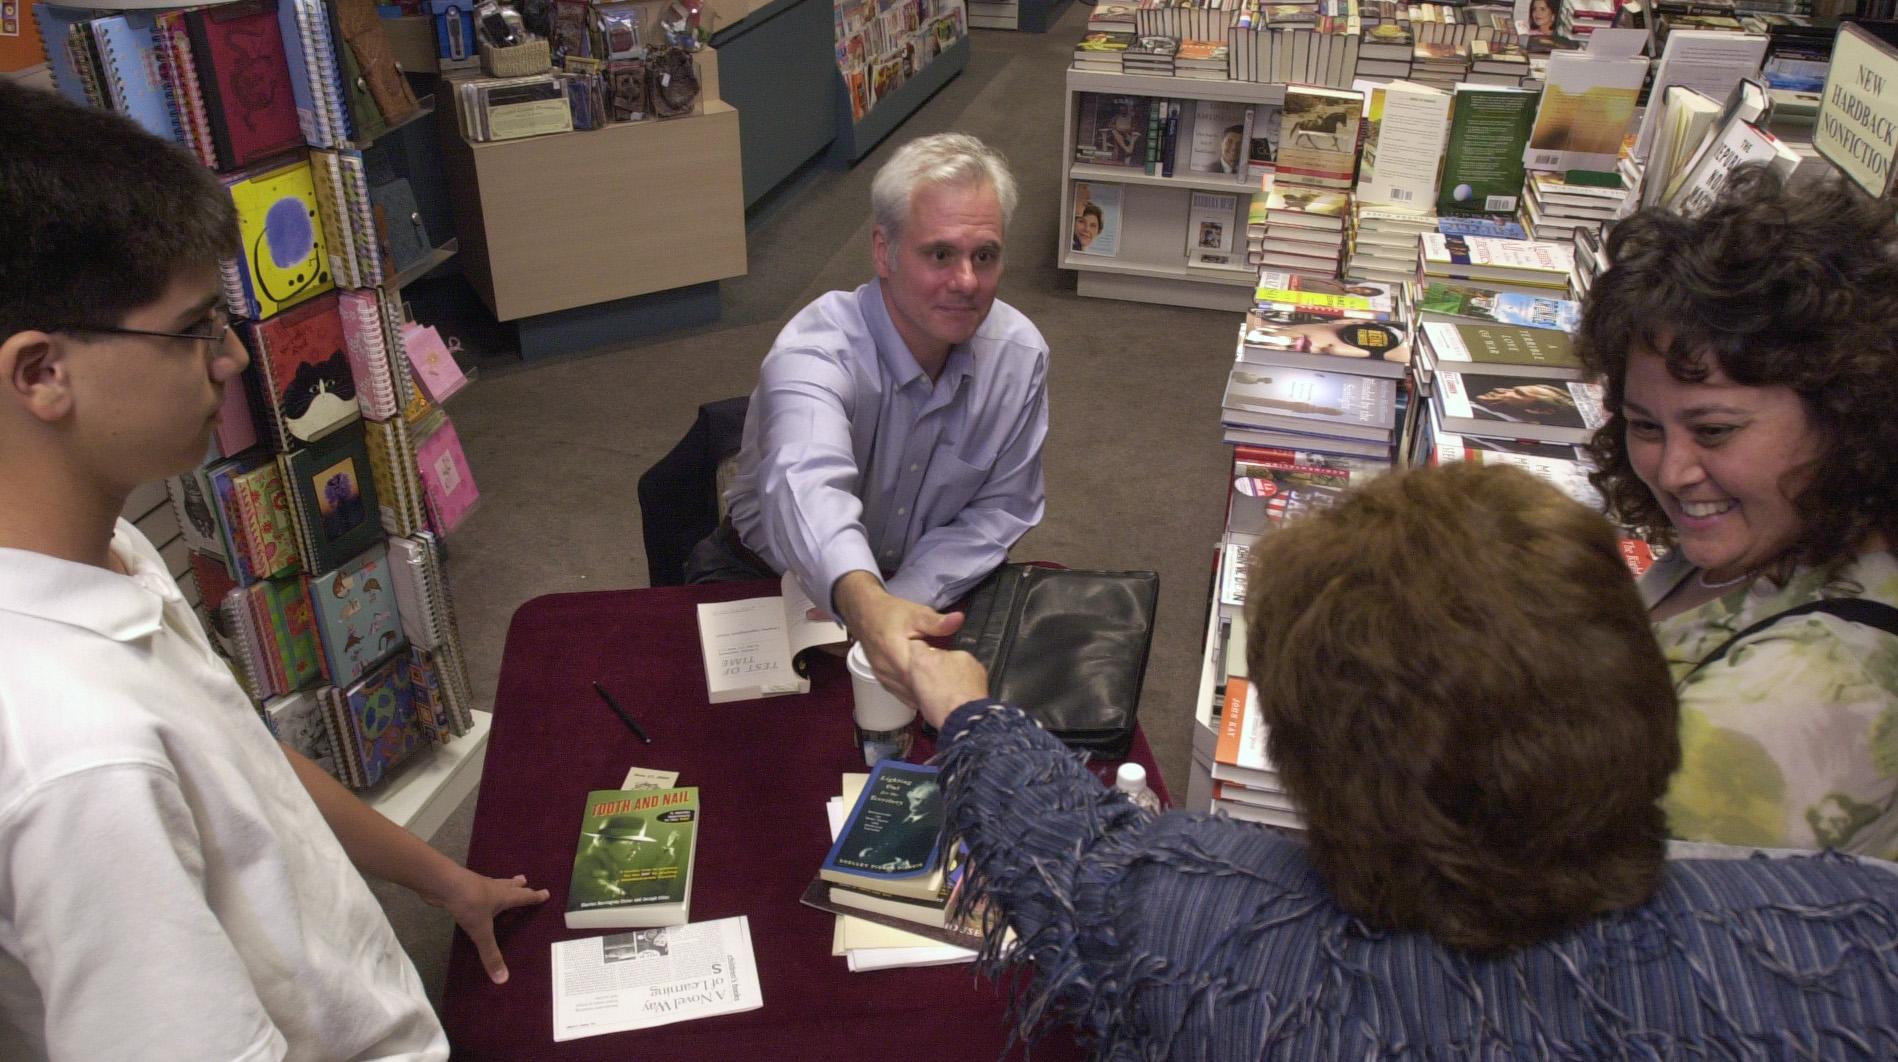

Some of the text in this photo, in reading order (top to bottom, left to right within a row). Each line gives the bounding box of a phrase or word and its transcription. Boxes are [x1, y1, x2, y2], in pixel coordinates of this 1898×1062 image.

[1856, 64, 1887, 97] NEW
[1831, 84, 1898, 147] HARDBACK
[1714, 142, 1742, 171] REPUBL
[1822, 112, 1893, 178] NONFICTION
[1501, 334, 1519, 352] LOVE
[1518, 329, 1545, 360] TERRIBLE
[720, 656, 755, 668] TIME
[722, 662, 778, 676] TEST OF
[1227, 697, 1241, 737] JOHN KAY
[592, 790, 689, 817] TOOTH AND NAIL
[711, 963, 722, 975] S
[641, 988, 727, 1013] A Novel Way
[648, 977, 724, 997] of Learning
